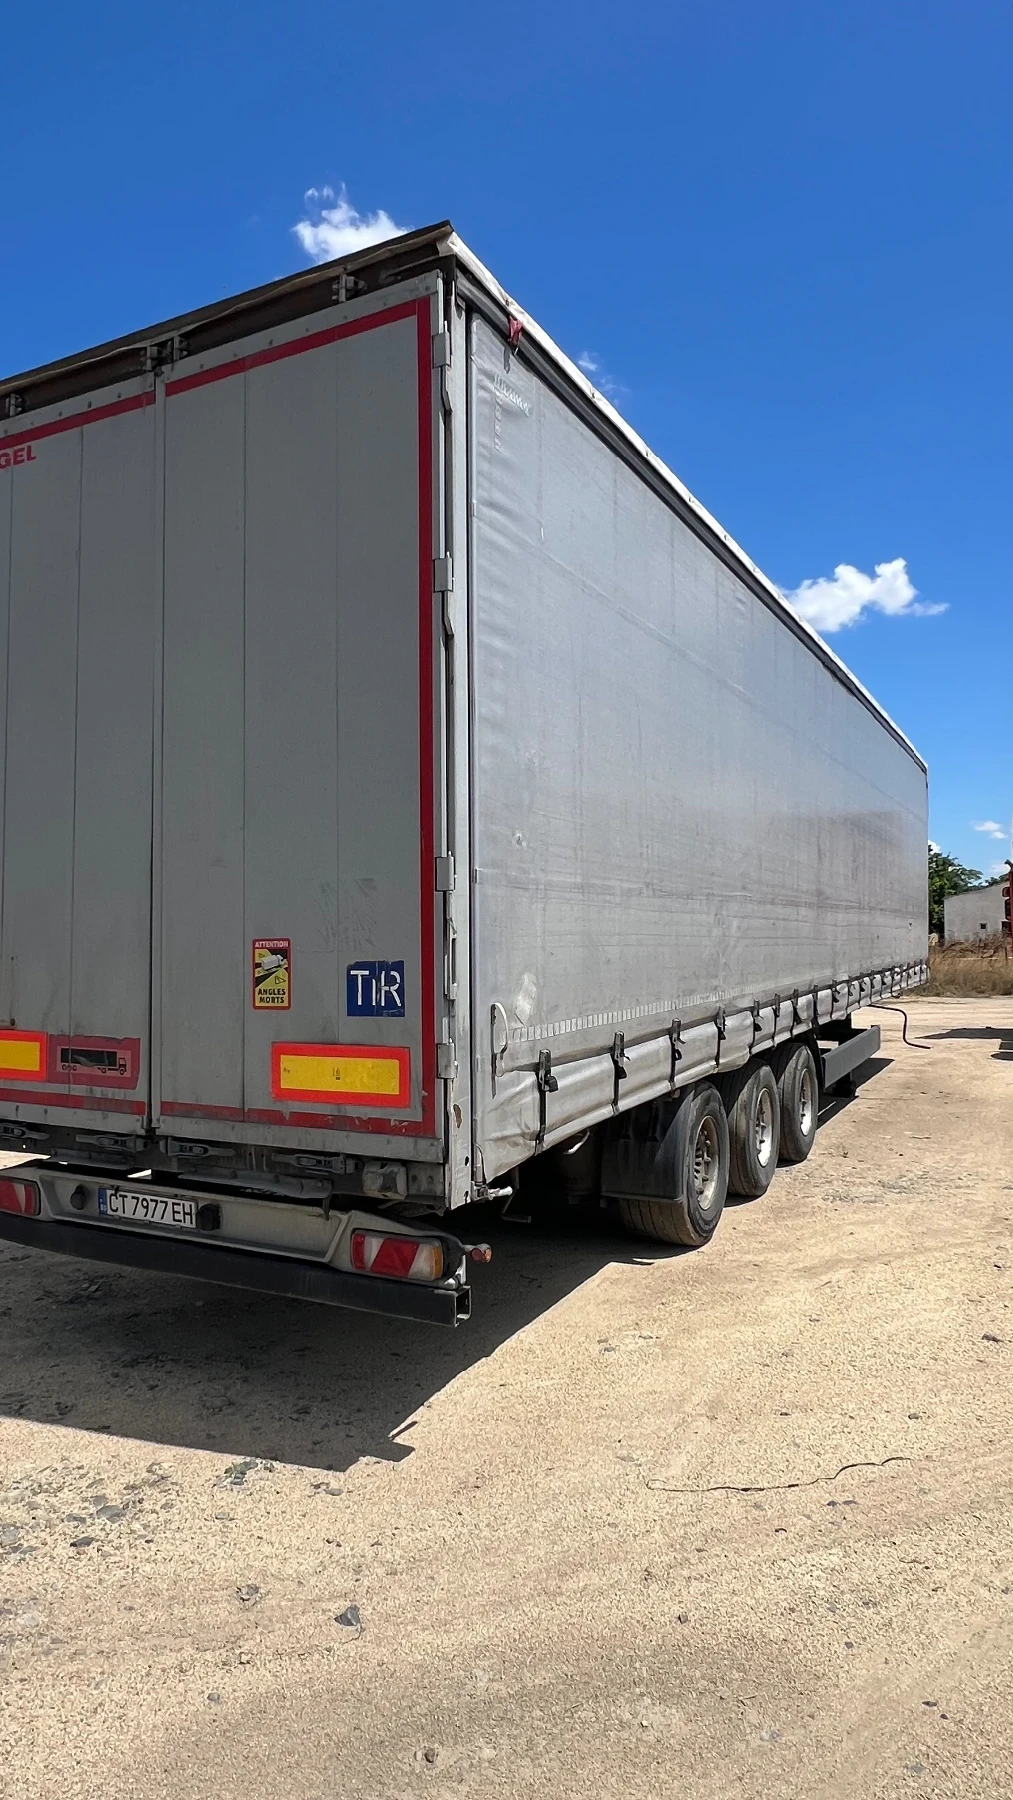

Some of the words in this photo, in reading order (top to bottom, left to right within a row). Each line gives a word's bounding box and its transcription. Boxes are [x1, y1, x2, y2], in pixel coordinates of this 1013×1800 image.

[254, 940, 289, 948] ATTENTION
[257, 988, 286, 996] ANGLES
[350, 970, 402, 1006] TIR
[259, 996, 285, 1004] MORTS
